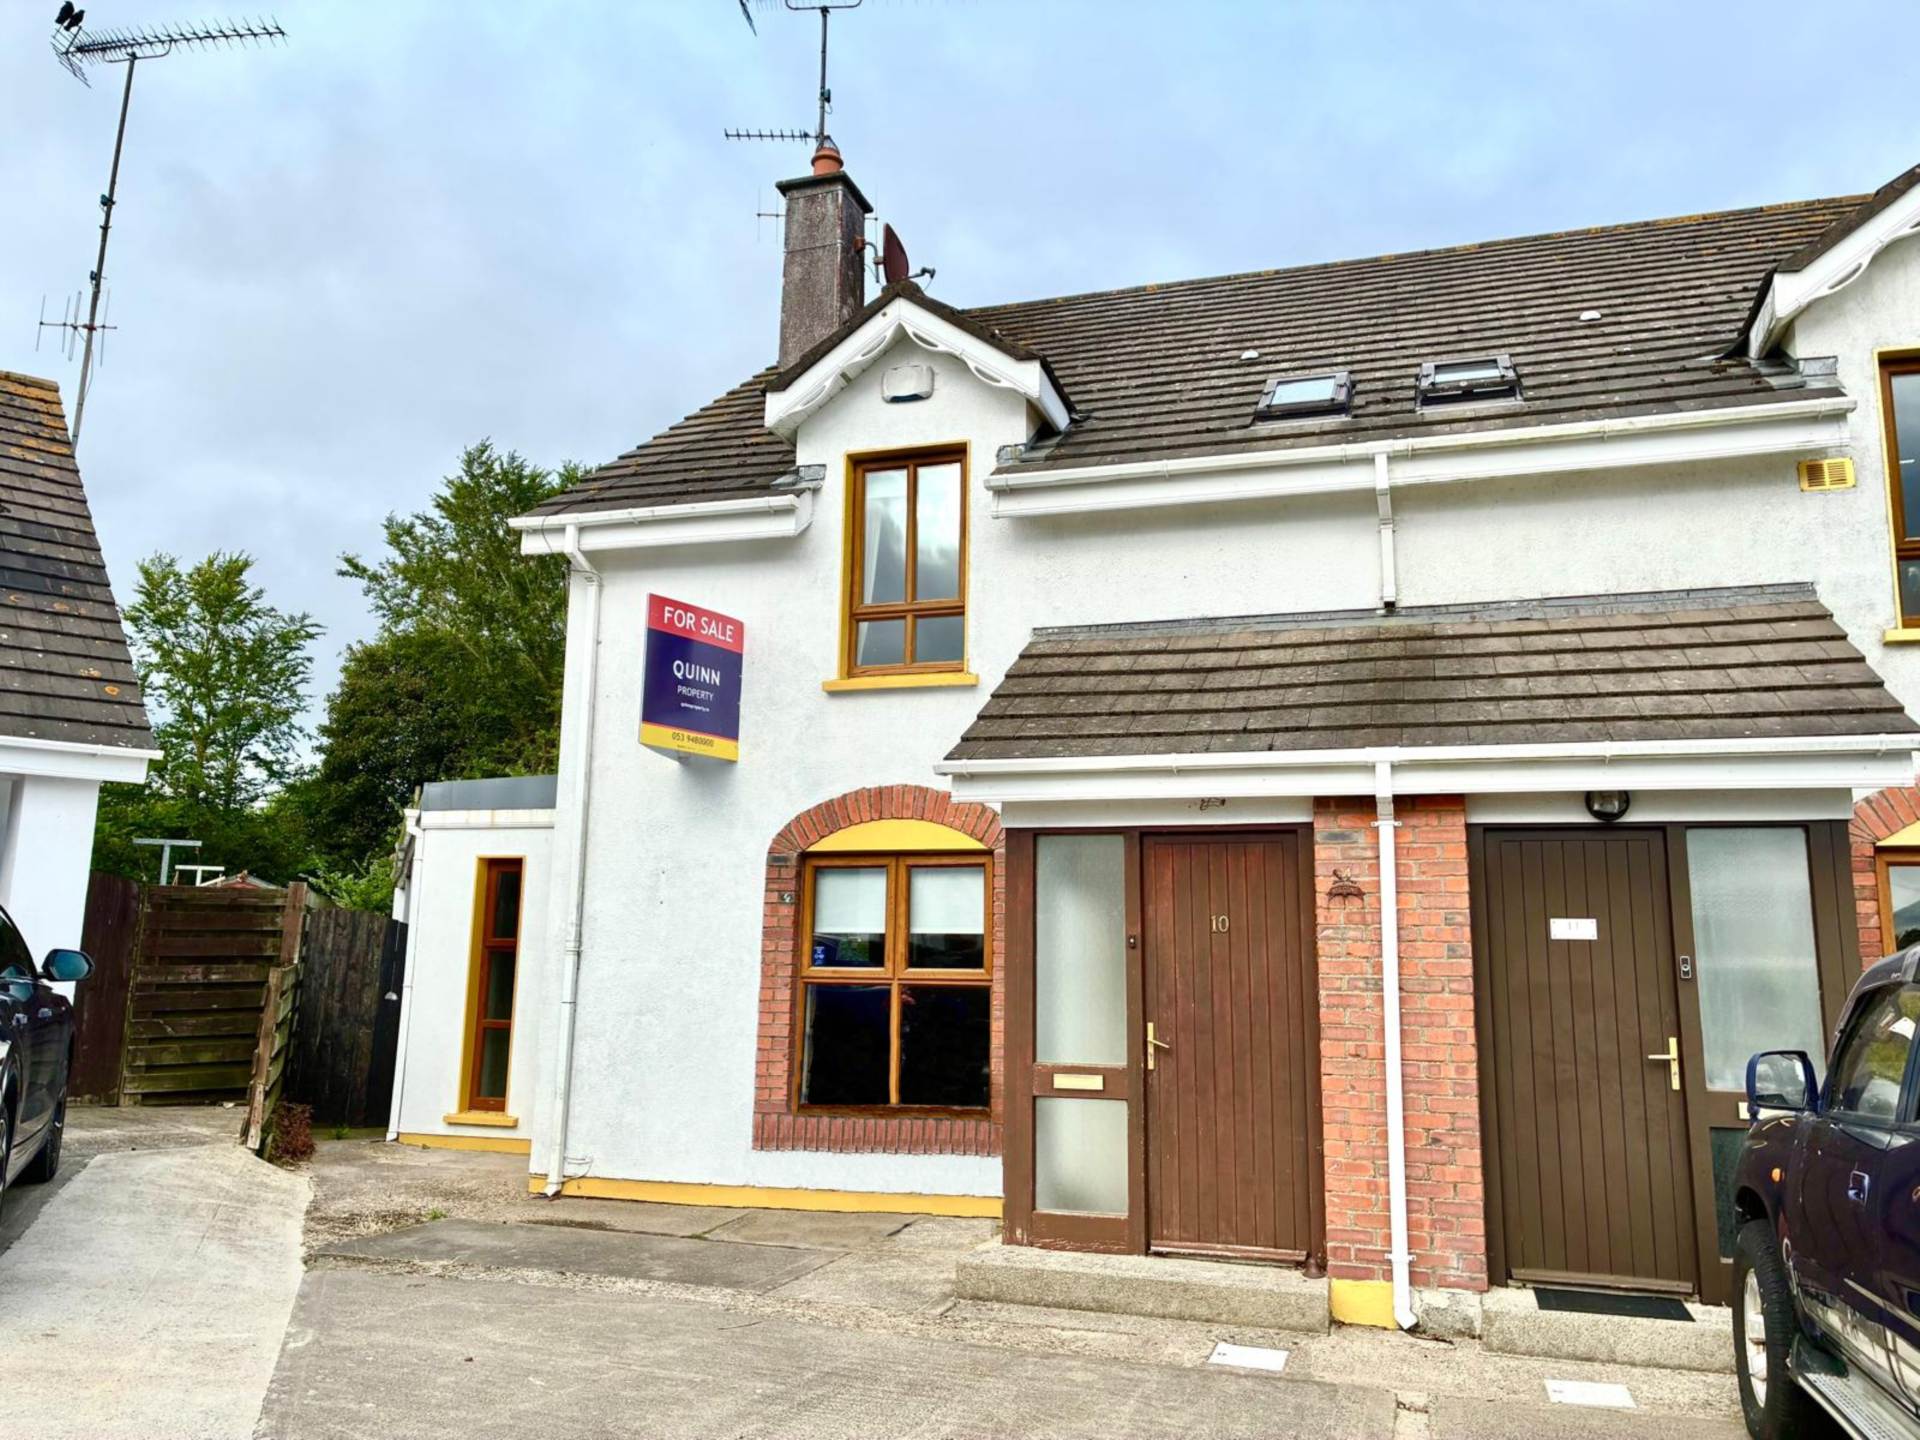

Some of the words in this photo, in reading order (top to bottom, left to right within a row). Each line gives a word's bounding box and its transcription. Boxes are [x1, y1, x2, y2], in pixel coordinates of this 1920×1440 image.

[663, 605, 696, 632] FOR
[700, 616, 734, 643] SALE
[672, 659, 720, 686] QUINN
[677, 684, 714, 701] PROPERTY
[671, 731, 685, 742] 053
[1210, 915, 1230, 932] 10
